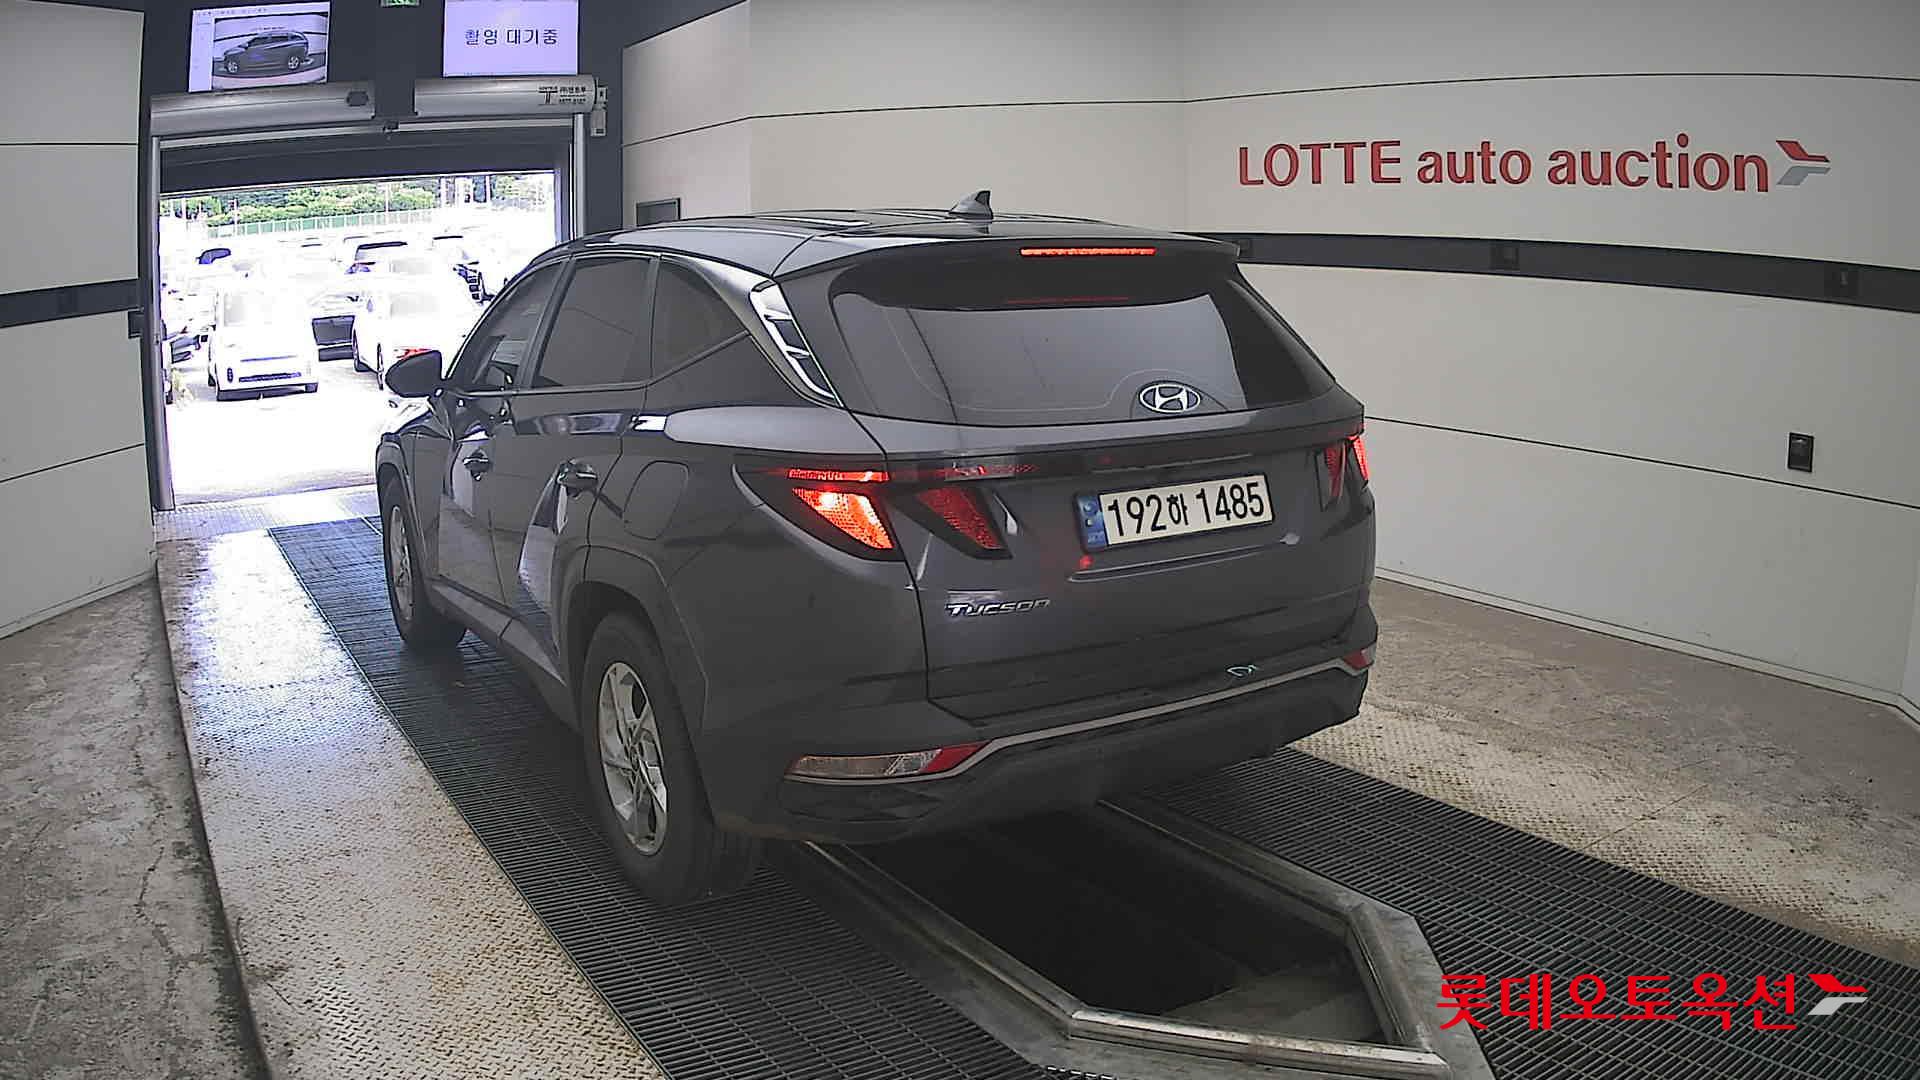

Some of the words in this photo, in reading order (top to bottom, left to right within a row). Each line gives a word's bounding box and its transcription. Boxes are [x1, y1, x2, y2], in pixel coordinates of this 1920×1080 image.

[465, 28, 498, 45] 촬영
[1239, 140, 1401, 186] LOTTE
[1417, 140, 1532, 186] auto
[1547, 133, 1769, 193] auction
[1108, 493, 1189, 537] 192하
[1196, 481, 1265, 524] 1485
